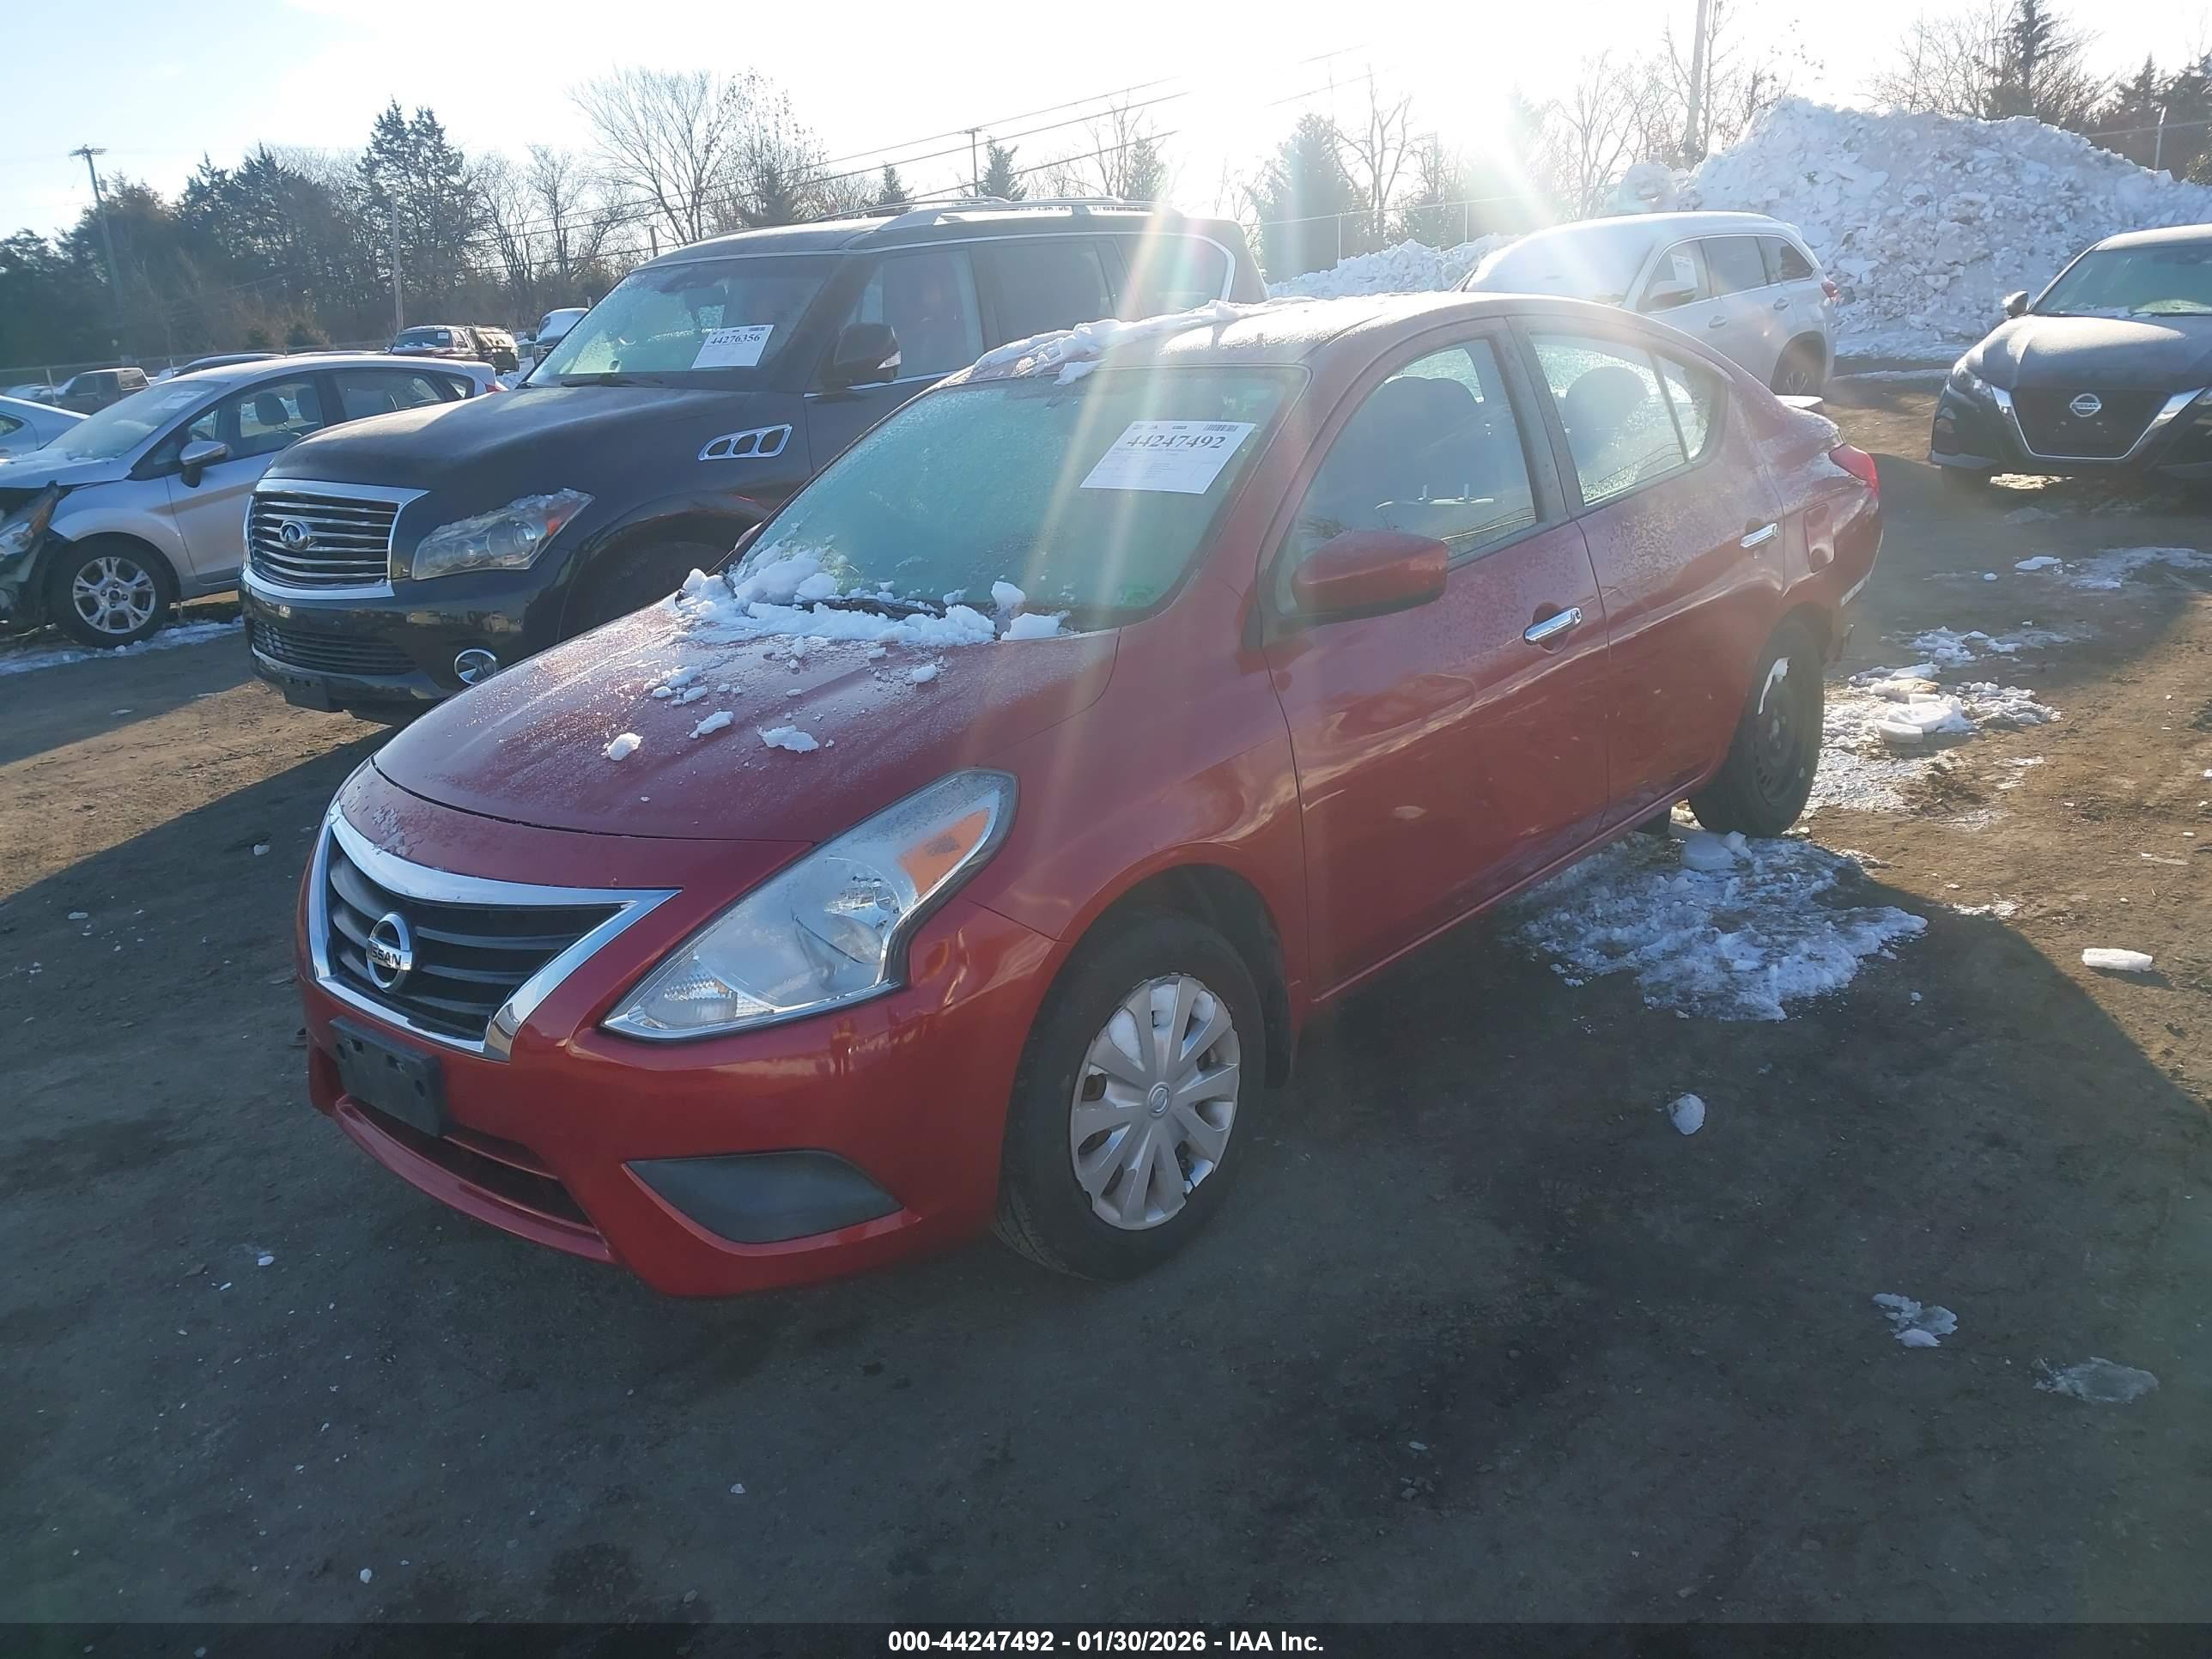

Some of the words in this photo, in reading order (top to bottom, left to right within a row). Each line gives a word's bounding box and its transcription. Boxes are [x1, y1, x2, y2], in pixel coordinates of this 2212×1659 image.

[711, 333, 761, 344] 44276356
[1127, 434, 1226, 449] 44247492
[367, 943, 402, 967] ISSAN
